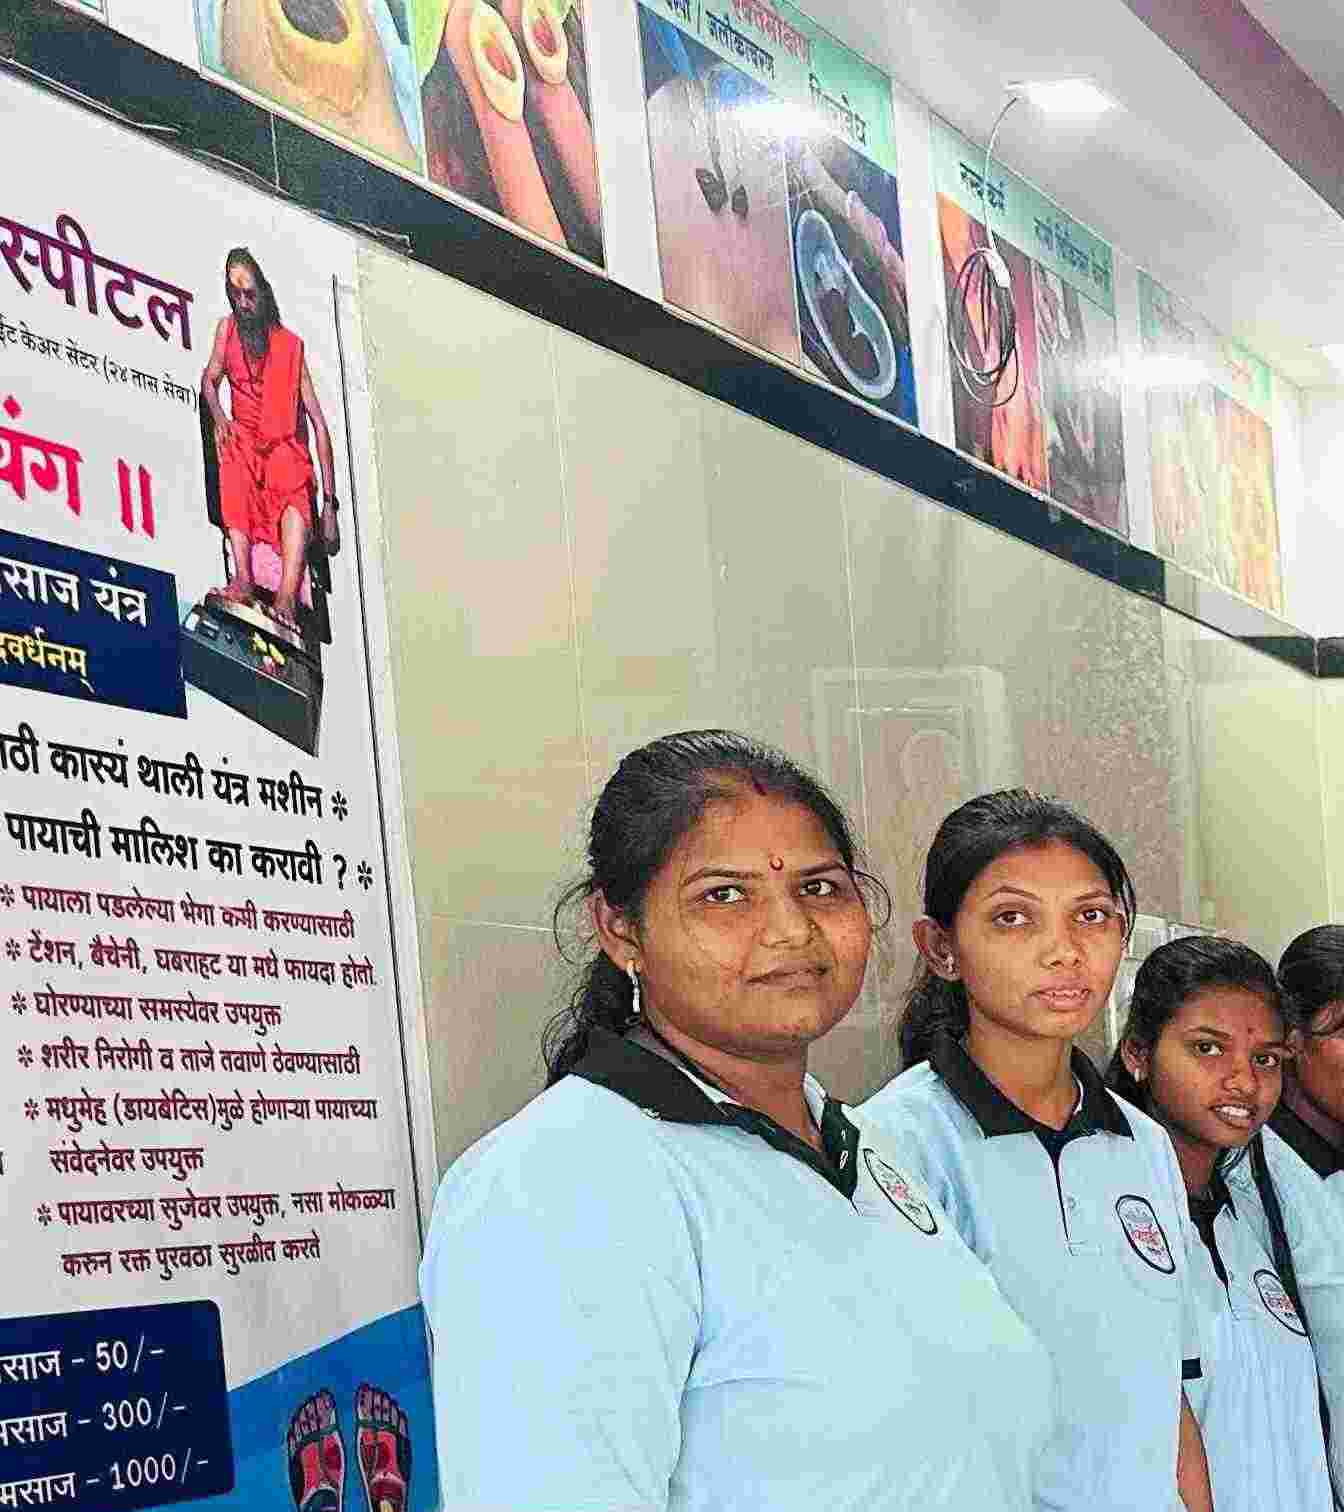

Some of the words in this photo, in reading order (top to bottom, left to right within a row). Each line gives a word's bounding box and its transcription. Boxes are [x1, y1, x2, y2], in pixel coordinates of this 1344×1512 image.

[0, 556, 80, 613] साज
[90, 564, 147, 627] यंत्र
[138, 751, 204, 799] थाली
[211, 756, 250, 807] यंत्र
[257, 770, 323, 818] मशीन
[4, 807, 102, 859] पायाची
[109, 815, 199, 870] मालिश
[206, 839, 243, 876] का
[249, 839, 323, 885] करावी
[21, 884, 91, 915] पायाला
[97, 886, 175, 922] पडलेल्या
[181, 891, 216, 927] भेगा
[262, 907, 356, 938] करण्यासाठी
[227, 952, 248, 978] या
[284, 958, 336, 986] फायदा
[138, 991, 219, 1024] समस्येवर
[225, 1003, 282, 1036] उपयुक्त
[41, 1036, 90, 1070] शरीर
[95, 1036, 152, 1072] निरोगी
[272, 1043, 361, 1075] ठेवण्यासाठी
[46, 1088, 106, 1133] मधुमेह
[49, 1140, 136, 1176] संवेदनेवर
[141, 1146, 205, 1181] उपयुक्त
[57, 1198, 155, 1227] पायावरच्या
[160, 1188, 221, 1231] सुजेवर
[156, 1243, 213, 1282] पुरवठा
[218, 1232, 276, 1277] सुरळीत
[0, 1349, 61, 1383] साज
[96, 1330, 165, 1374] 50/-
[102, 1391, 186, 1431] 300/-
[110, 1448, 209, 1490] 1000/-
